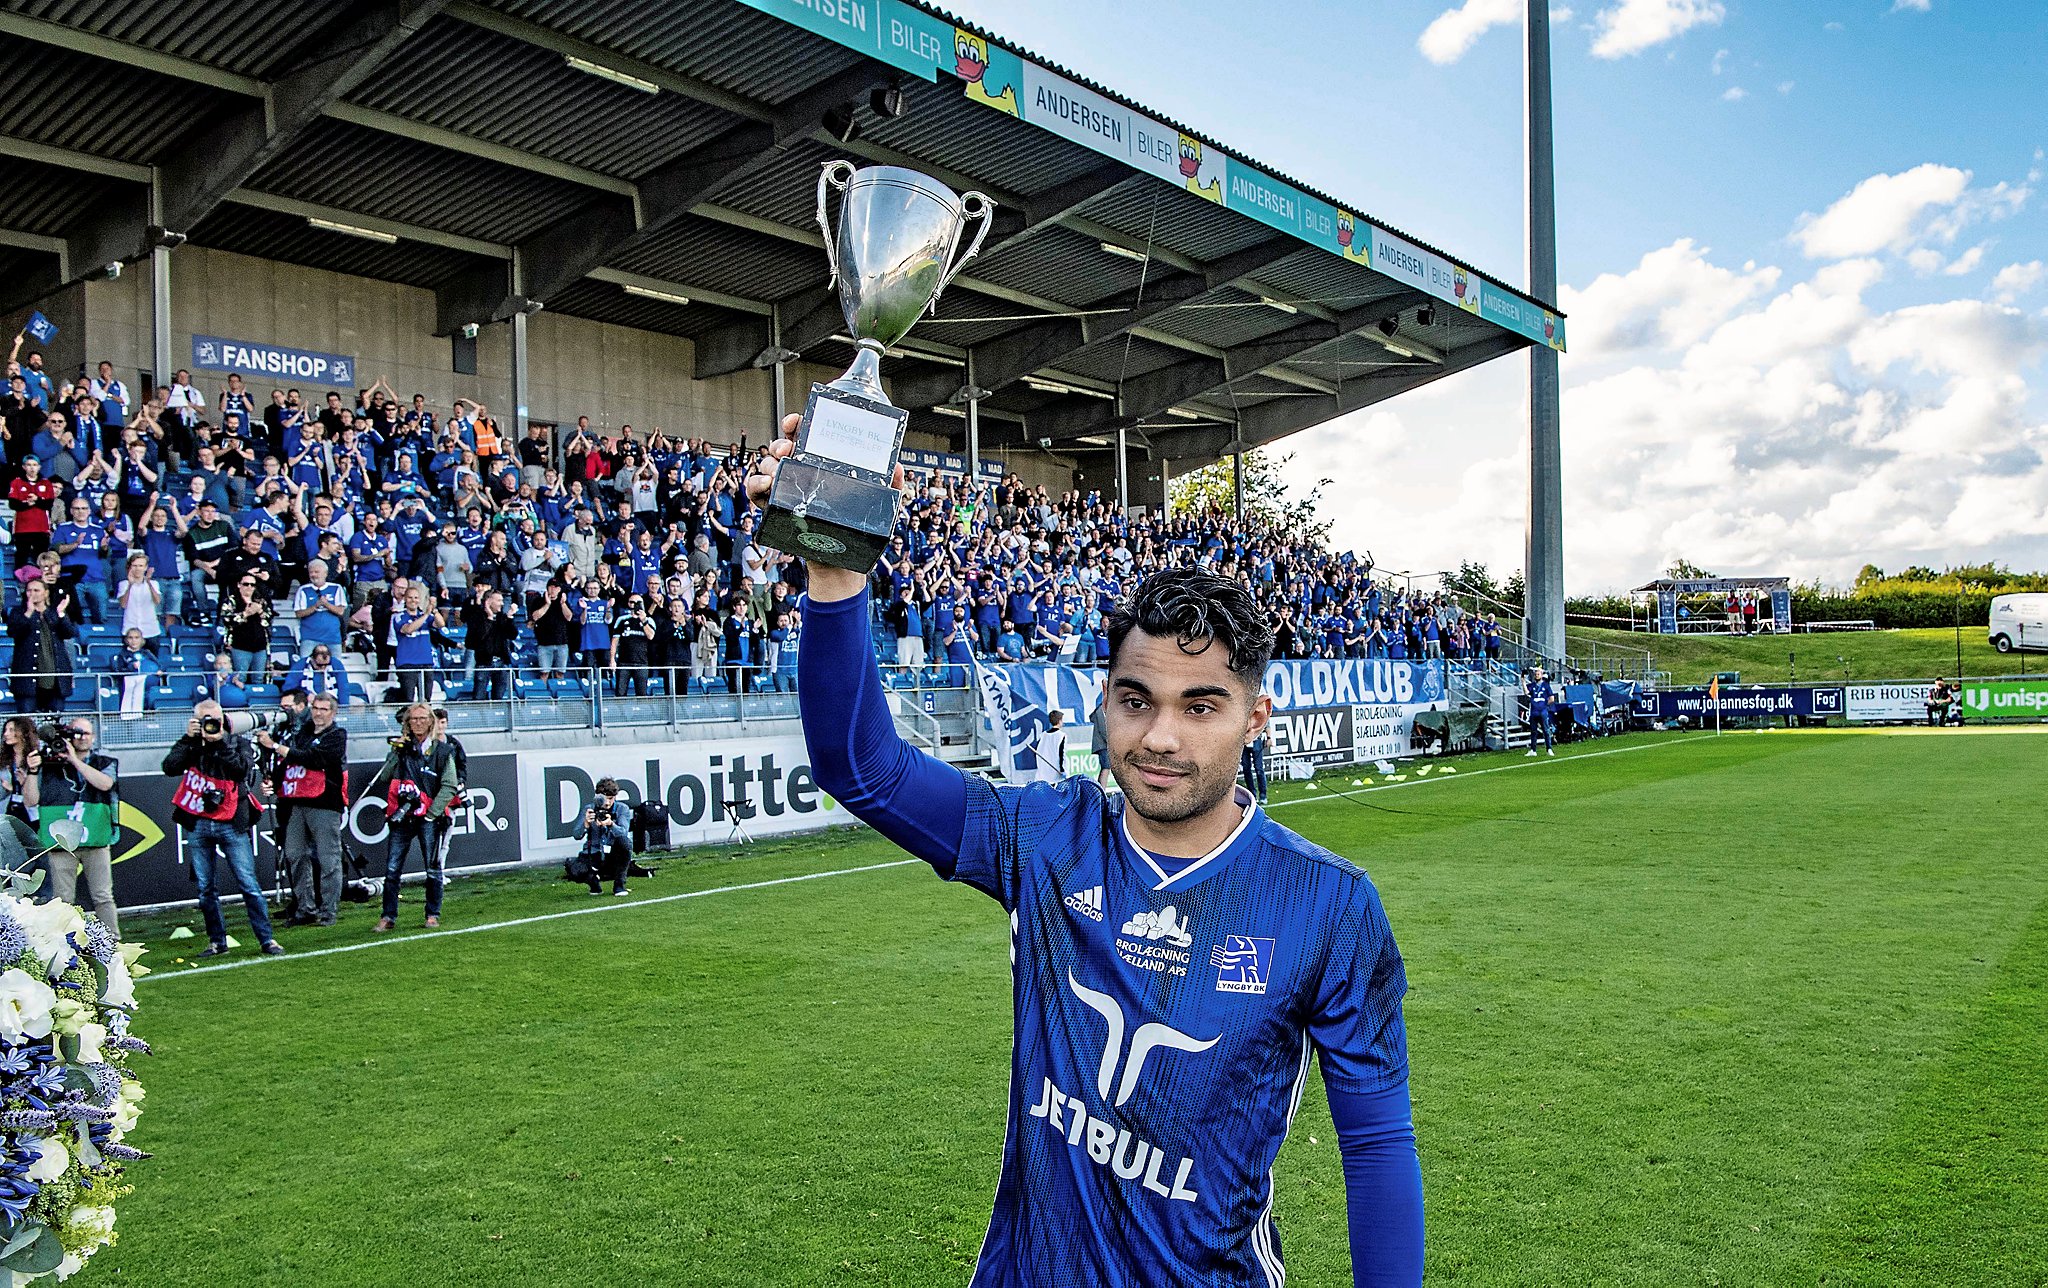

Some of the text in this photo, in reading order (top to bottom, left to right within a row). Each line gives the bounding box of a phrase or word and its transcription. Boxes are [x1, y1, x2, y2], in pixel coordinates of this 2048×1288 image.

[891, 19, 942, 65] BILER
[1036, 85, 1173, 165] ANDERSEN BILER
[1232, 175, 1331, 236] ANDERSEN BILER
[1378, 242, 1451, 289] ANDERSEN BILER
[1483, 292, 1520, 321] ANDERSEN
[222, 345, 327, 378] FANSHOP
[826, 418, 881, 441] LYNGBY BK
[900, 450, 962, 469] MAD BAR MAD
[988, 463, 1003, 474] MAD
[1259, 660, 1414, 709] OLDKLUB
[1850, 687, 1929, 700] RIB HOUSE
[1641, 698, 1655, 711] og
[1677, 694, 1794, 713] www.johannesfog.dk
[1816, 693, 1838, 709] Fog
[1994, 687, 2048, 711] unisp
[1356, 705, 1403, 720] BROLÆGNING
[1356, 724, 1404, 738] SJÆLLAND APS
[543, 753, 822, 841] Deloitte
[1063, 896, 1103, 922] adidas
[1115, 938, 1190, 964] BROLÆGNING
[1168, 965, 1187, 977] APS
[1217, 982, 1266, 992] LYNGBY BK
[1029, 1076, 1198, 1202] JETBULL
